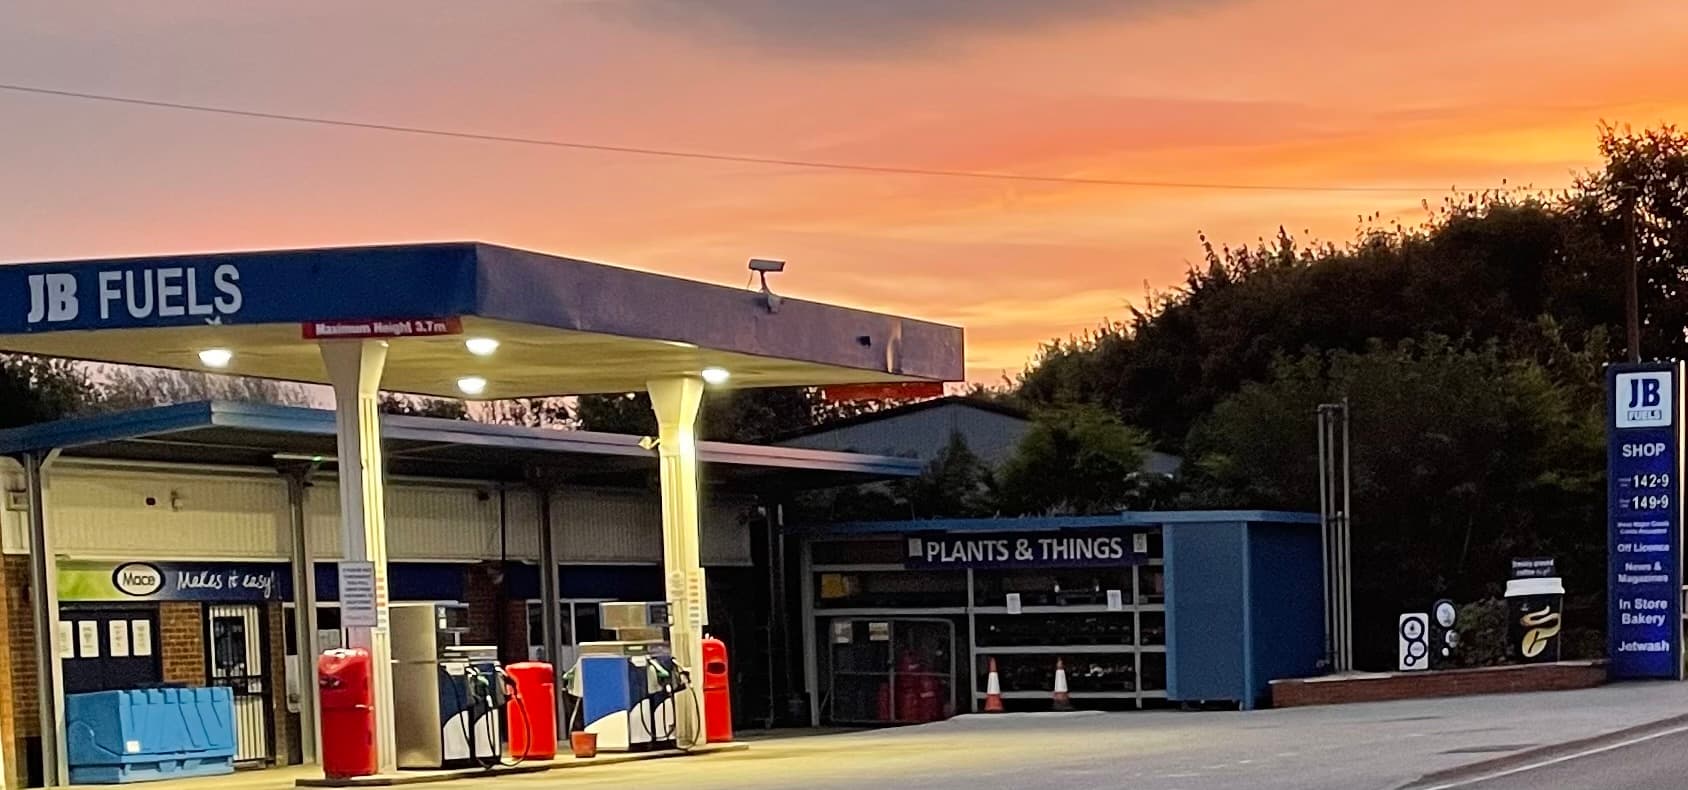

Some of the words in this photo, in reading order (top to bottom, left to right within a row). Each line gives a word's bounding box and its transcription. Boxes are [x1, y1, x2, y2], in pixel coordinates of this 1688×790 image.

[28, 273, 79, 323] JB
[99, 264, 242, 319] FUELS
[315, 323, 371, 336] Maximum
[372, 320, 412, 335] Height
[415, 320, 448, 333] 3.7m
[1629, 378, 1661, 408] JB
[1622, 443, 1666, 457] SHOP
[926, 540, 1009, 562] PLANTS
[1015, 538, 1034, 561] &
[1038, 537, 1123, 560] THINGS
[1617, 543, 1632, 552] Off
[1625, 562, 1652, 572] News
[1654, 561, 1662, 571] &
[122, 572, 156, 586] Mace
[177, 571, 223, 590] Makes
[228, 570, 239, 588] it
[242, 571, 275, 599] easy!
[1618, 574, 1668, 584] Magazines
[1619, 599, 1631, 609] In
[1634, 598, 1668, 609] Store
[1622, 613, 1665, 626] Bakery
[1618, 640, 1670, 652] Jetwash
